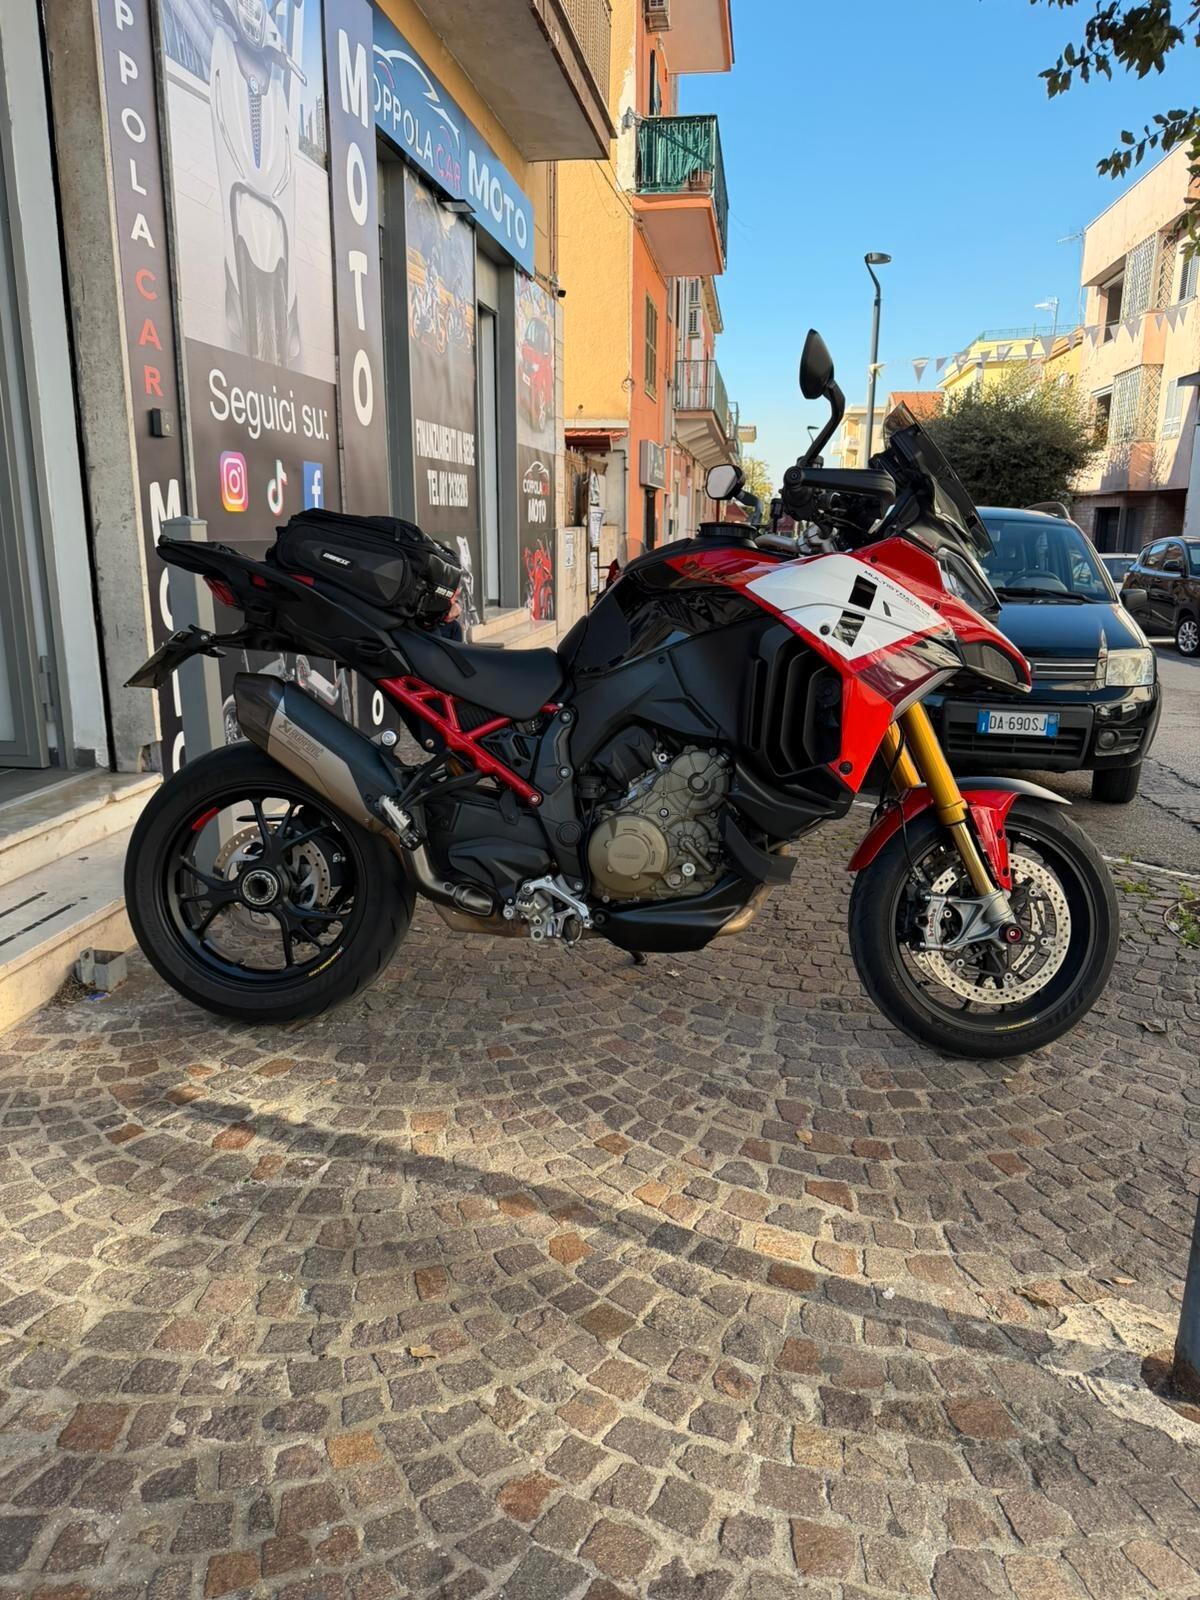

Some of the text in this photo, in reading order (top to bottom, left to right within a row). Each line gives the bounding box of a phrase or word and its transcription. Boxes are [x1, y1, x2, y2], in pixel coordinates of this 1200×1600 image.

[435, 143, 462, 193] CAR
[468, 150, 527, 249] MOTO
[338, 28, 373, 427] MOTO
[135, 268, 164, 398] CAR
[208, 368, 329, 441] Seguici su:
[528, 498, 546, 523] MOTO
[989, 715, 1047, 731] DA 690SJ
